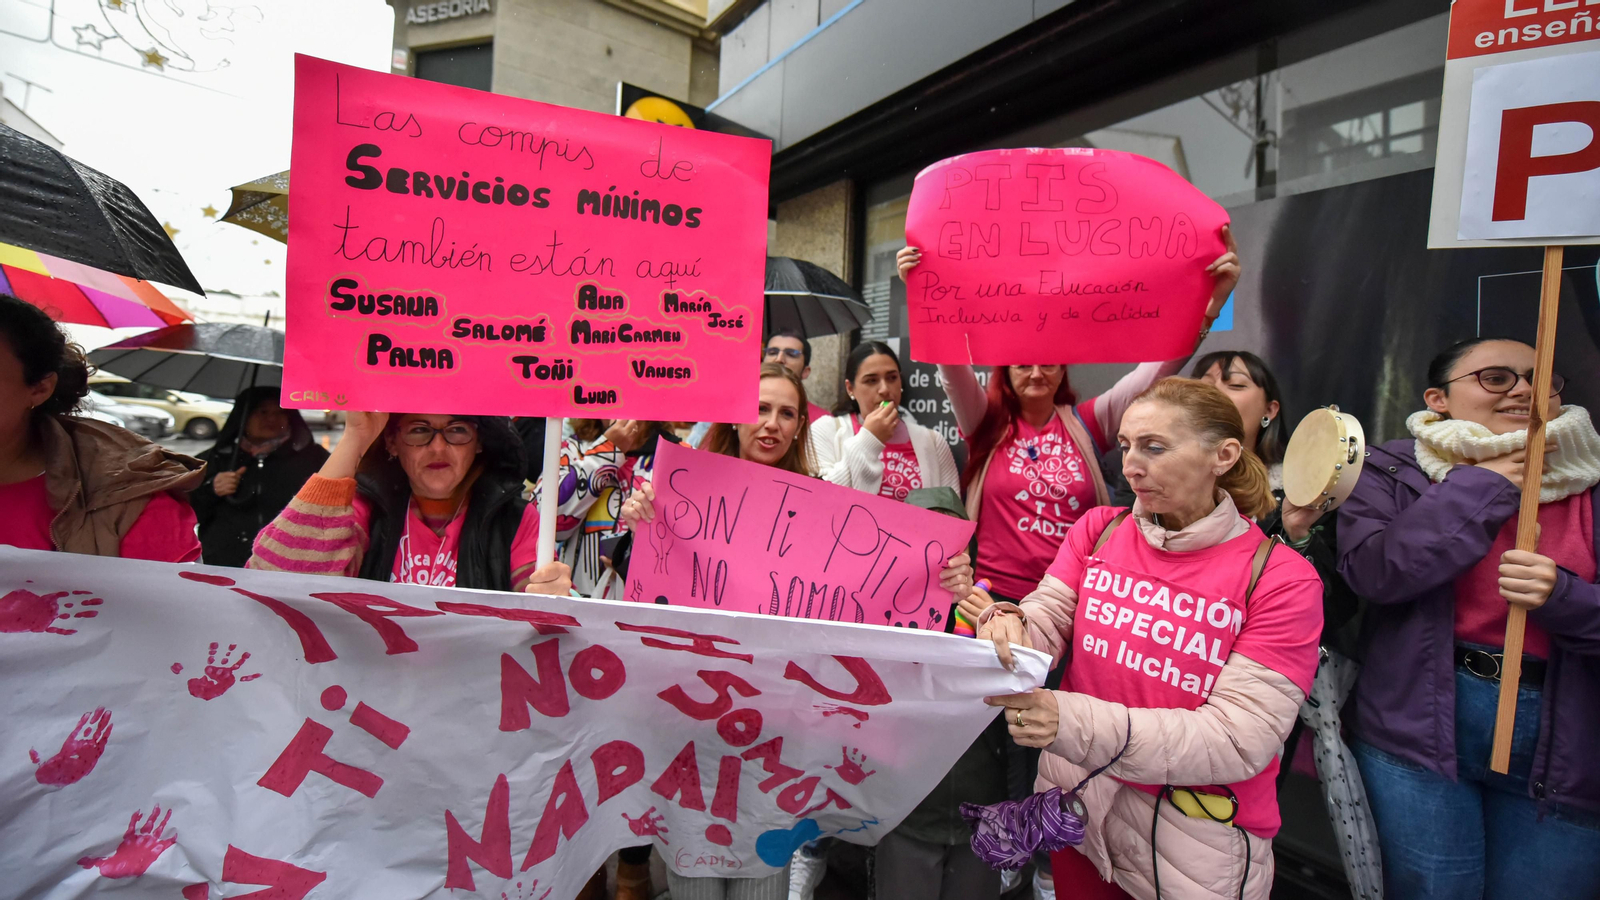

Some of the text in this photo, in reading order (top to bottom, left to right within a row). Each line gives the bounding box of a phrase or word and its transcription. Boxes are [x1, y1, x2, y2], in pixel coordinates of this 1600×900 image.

[336, 73, 694, 182] Las compis de
[939, 162, 1118, 214] PTIS
[334, 205, 702, 289] también están aquí
[938, 212, 1198, 260] EN LUCHA
[918, 270, 1148, 302] Por una Educación
[918, 302, 1160, 332] Inclusiva y de Calidad
[290, 391, 330, 402] CRIS
[908, 399, 937, 413] con
[909, 369, 929, 387] de
[663, 468, 748, 544] SIN
[832, 504, 944, 614] PTIS
[692, 552, 727, 606] NO
[1083, 568, 1244, 637] EDUCACIÓN
[1084, 597, 1226, 668] ESPECIAL
[499, 638, 626, 732] NO
[1082, 634, 1215, 699] en lucha!
[445, 741, 743, 893] NADA!
